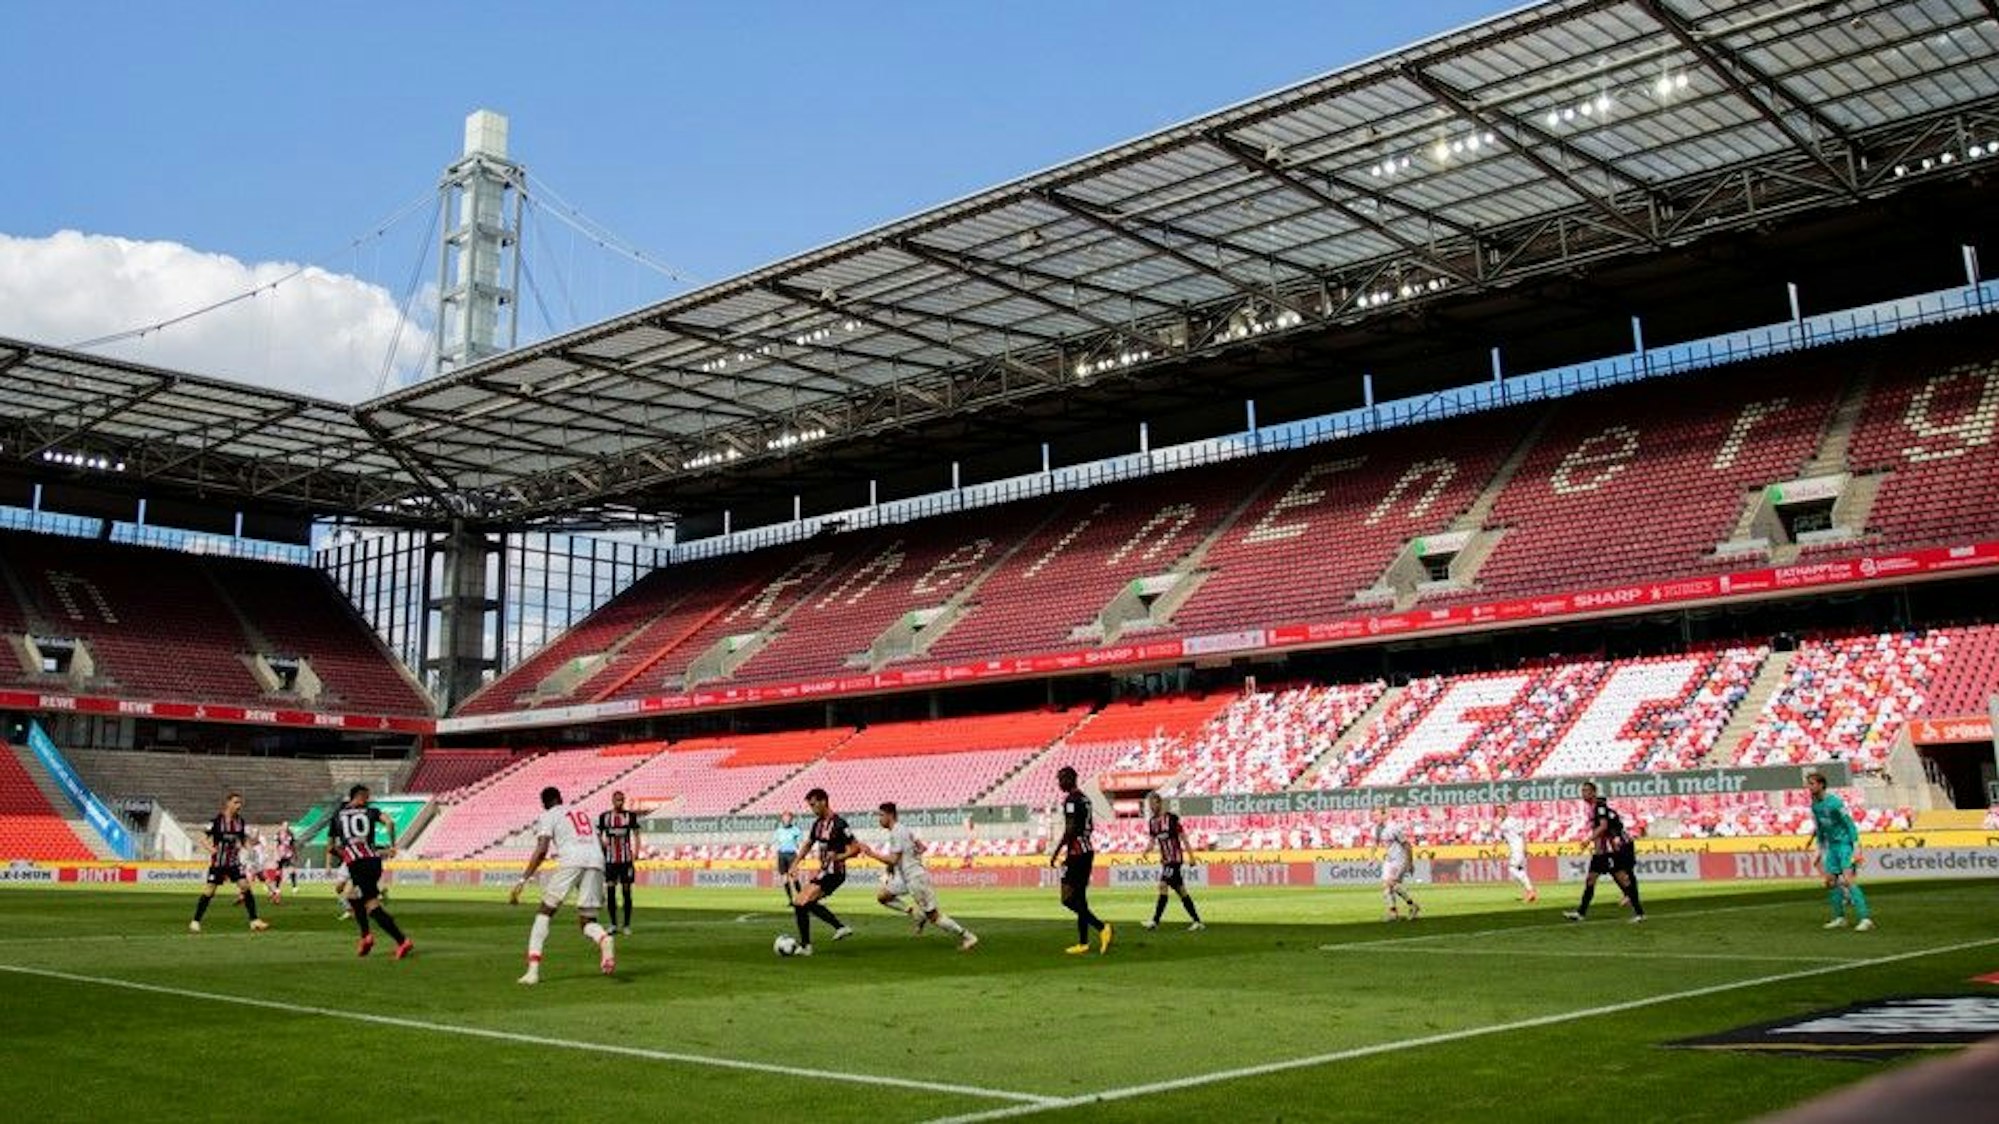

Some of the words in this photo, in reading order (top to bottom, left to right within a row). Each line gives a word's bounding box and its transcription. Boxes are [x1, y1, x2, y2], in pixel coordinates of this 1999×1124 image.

[1573, 588, 1643, 608] SHARP
[1085, 648, 1134, 664] SHARP
[39, 695, 77, 710] REWE
[118, 701, 154, 714] REWE
[244, 709, 277, 722] REWE
[1212, 791, 1292, 815] Bäckerei
[1295, 788, 1394, 812] Schneider
[1407, 783, 1512, 806] Schmeckt
[1610, 773, 1671, 797] nach
[1676, 770, 1747, 795] mehr
[340, 813, 370, 839] 10
[565, 809, 593, 837] 19
